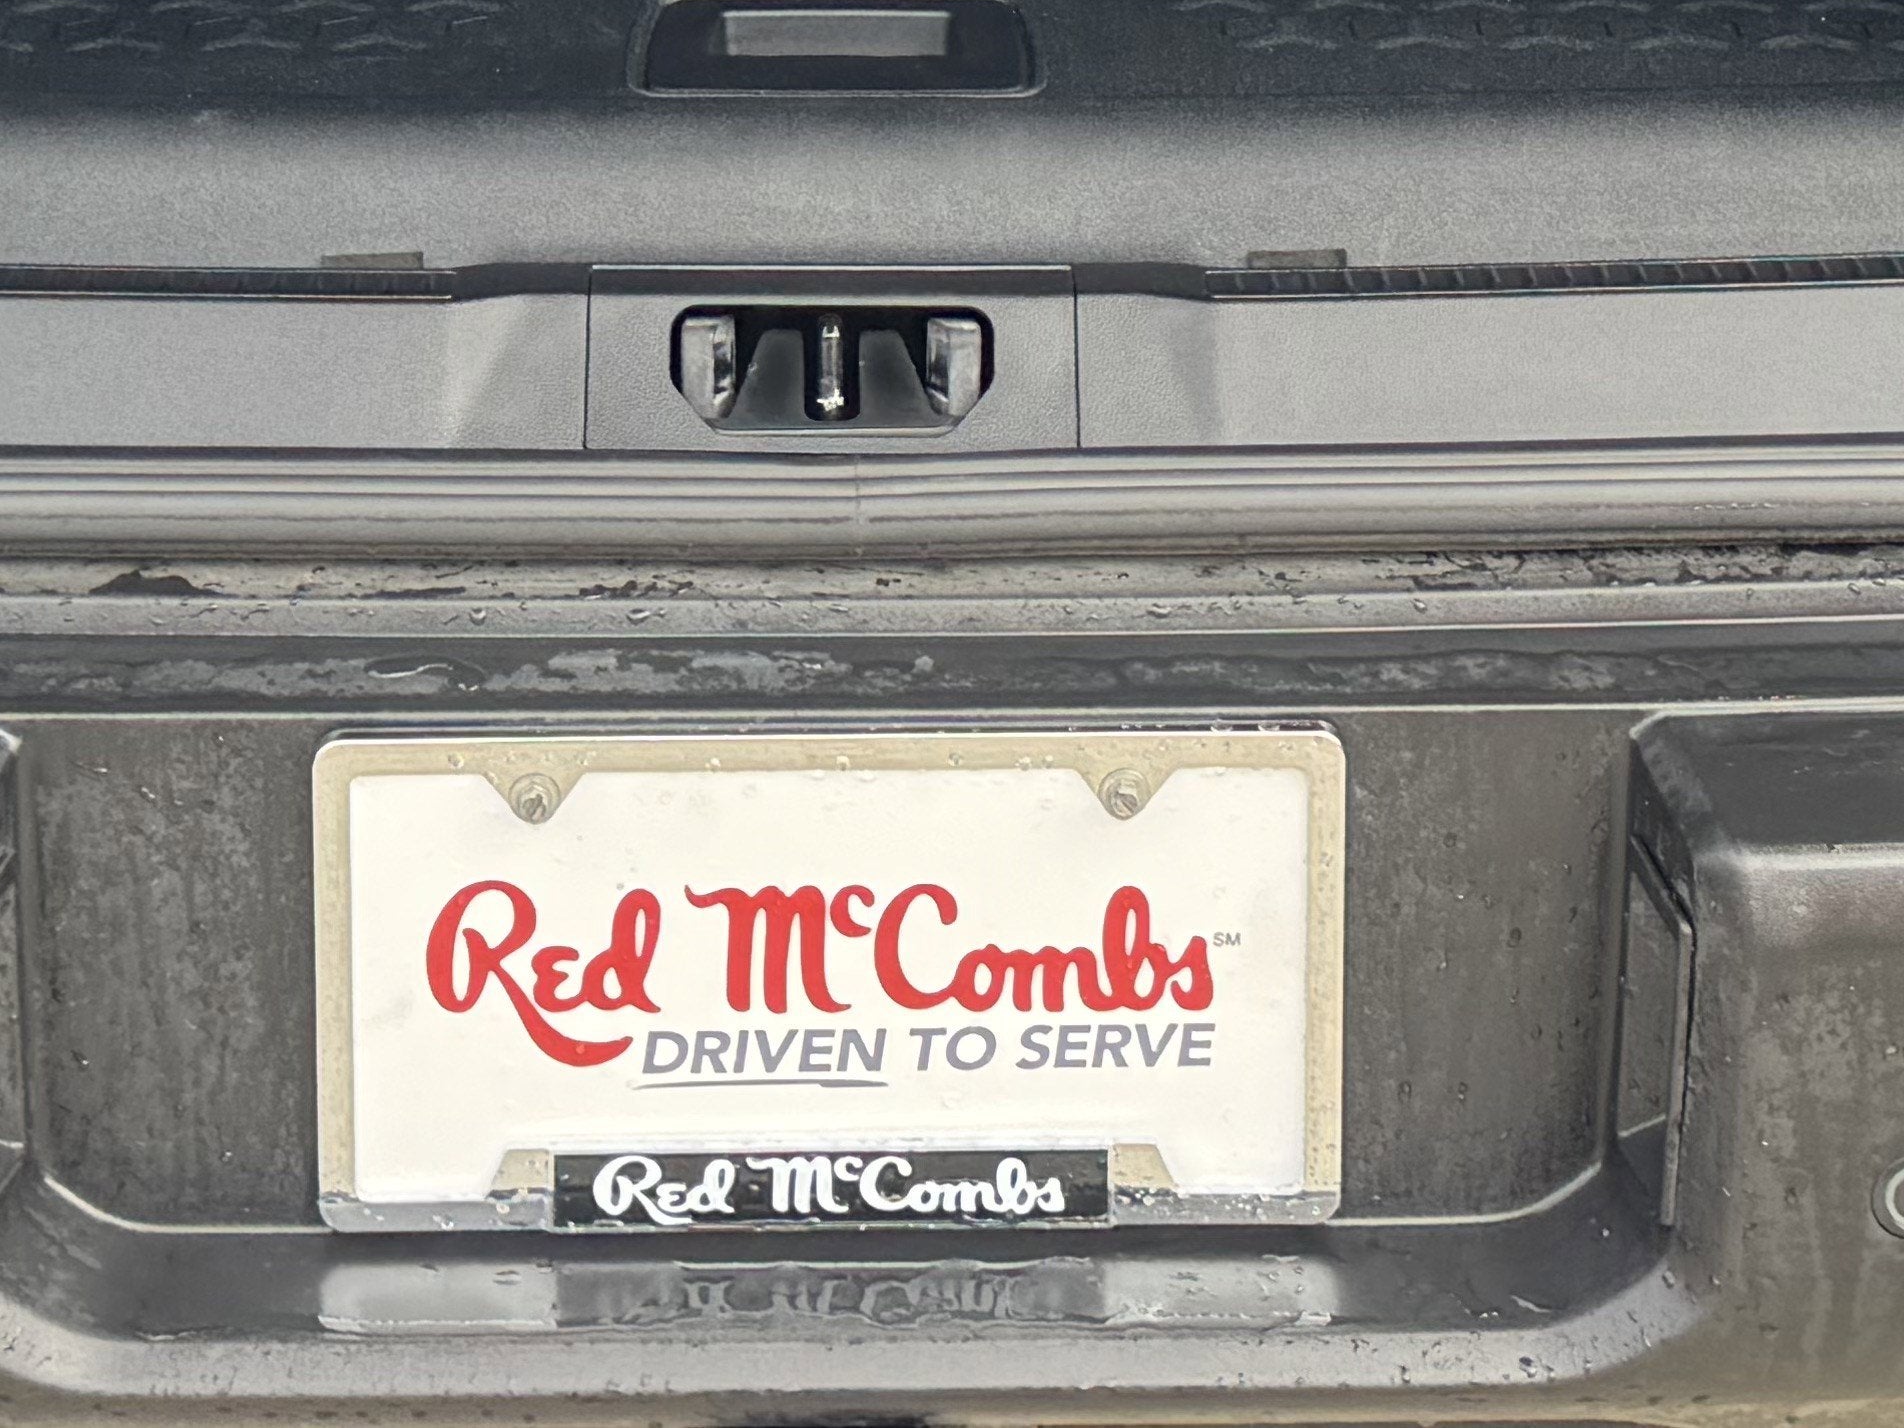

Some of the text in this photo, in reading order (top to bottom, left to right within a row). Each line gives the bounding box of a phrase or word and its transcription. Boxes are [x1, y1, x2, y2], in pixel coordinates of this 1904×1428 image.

[426, 881, 661, 1067] Red
[685, 884, 1214, 1014] McCombs
[641, 1022, 1216, 1074] DRIVEN TO SERVE
[592, 1154, 1066, 1225] Red McCombs
